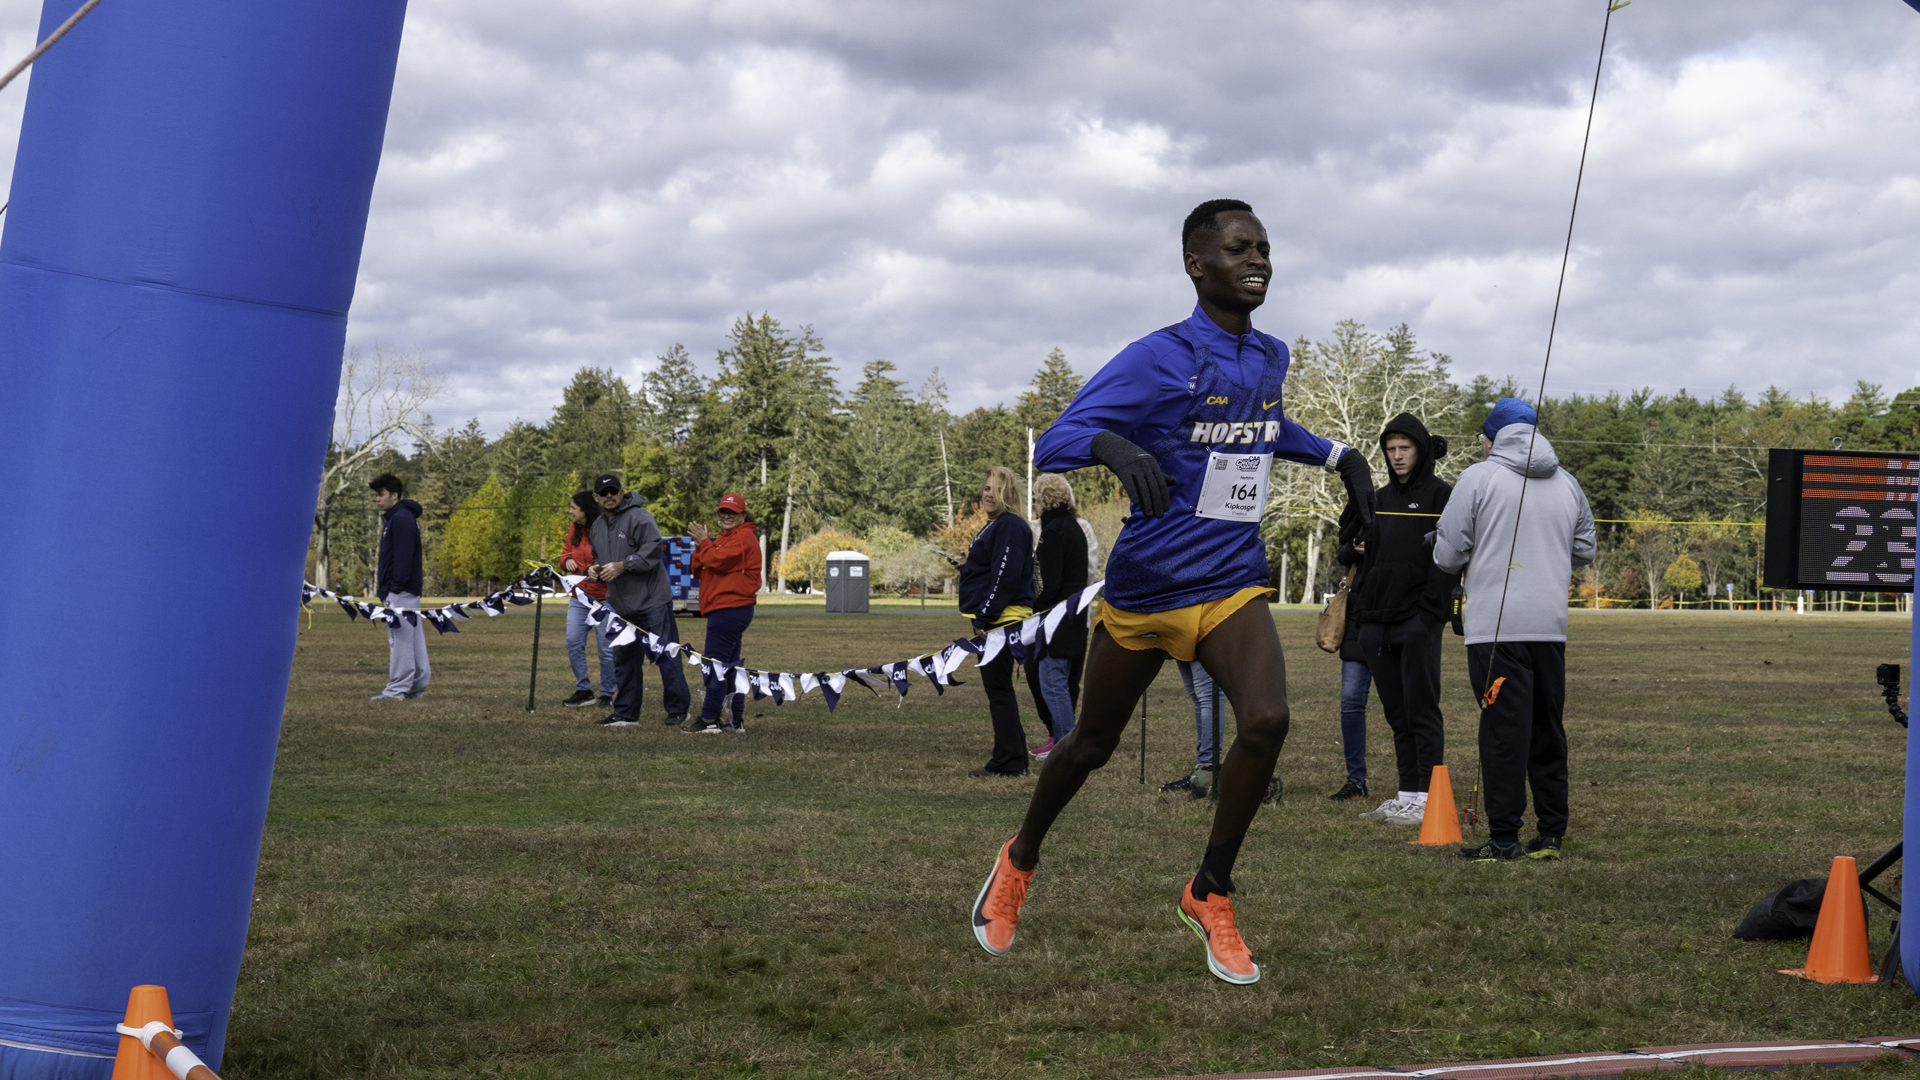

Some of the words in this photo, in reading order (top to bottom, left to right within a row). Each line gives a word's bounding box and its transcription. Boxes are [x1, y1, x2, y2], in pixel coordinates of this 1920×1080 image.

[1206, 396, 1229, 405] CAA
[1231, 484, 1257, 501] 164
[1224, 502, 1257, 512] Kipkosgei
[1826, 506, 1916, 582] 23
[1008, 631, 1022, 645] CA
